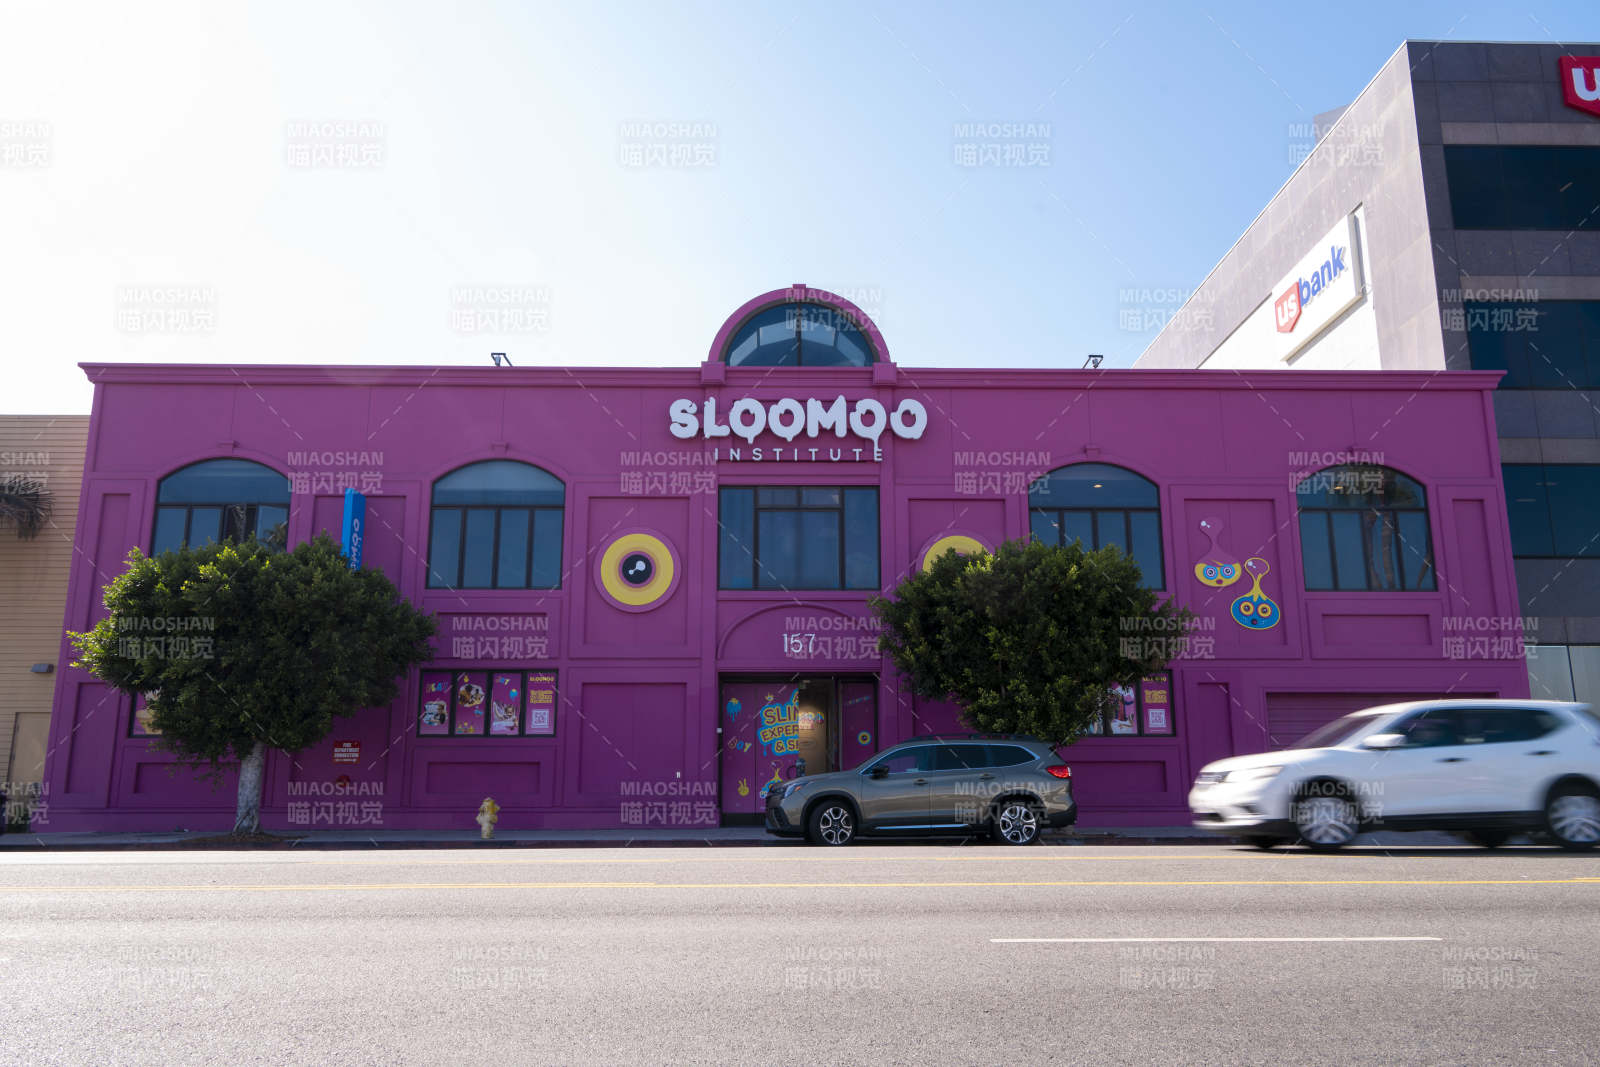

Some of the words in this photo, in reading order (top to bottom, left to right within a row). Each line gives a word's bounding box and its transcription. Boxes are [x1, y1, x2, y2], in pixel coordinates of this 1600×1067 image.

[1299, 245, 1345, 308] bank
[669, 395, 928, 446] SLOOMOO
[715, 448, 883, 462] INSTITUTE
[783, 633, 816, 653] 157
[775, 740, 786, 753] &
